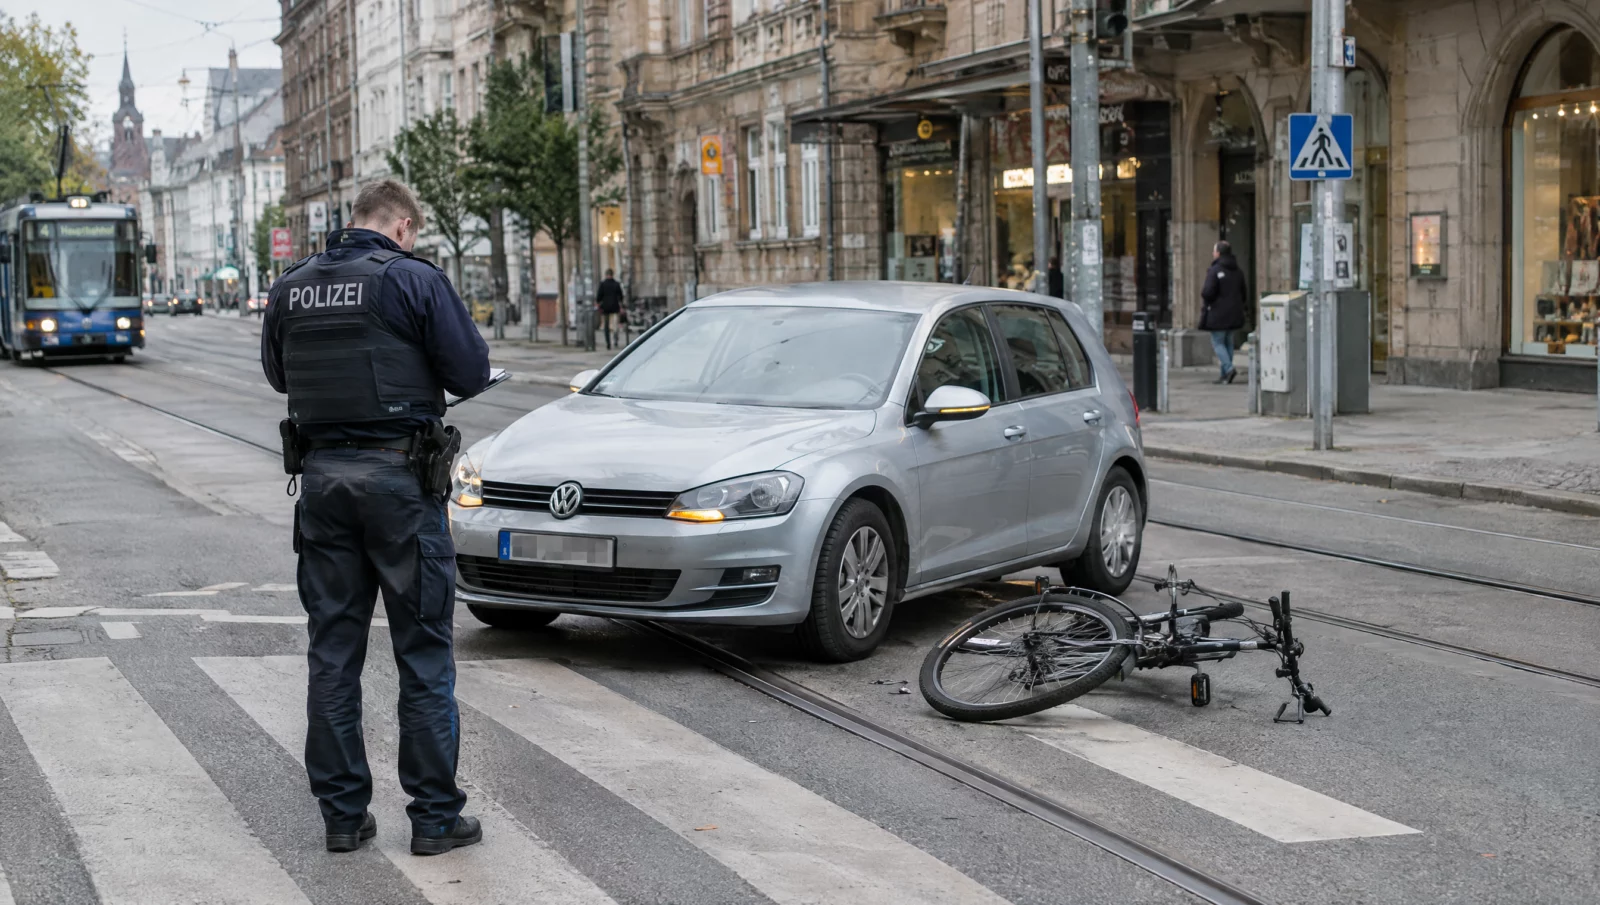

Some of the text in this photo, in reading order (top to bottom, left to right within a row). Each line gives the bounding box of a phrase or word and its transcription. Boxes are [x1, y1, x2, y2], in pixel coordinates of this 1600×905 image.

[40, 224, 49, 237] 4
[289, 283, 363, 310] POLIZEI
[551, 484, 581, 516] VW
